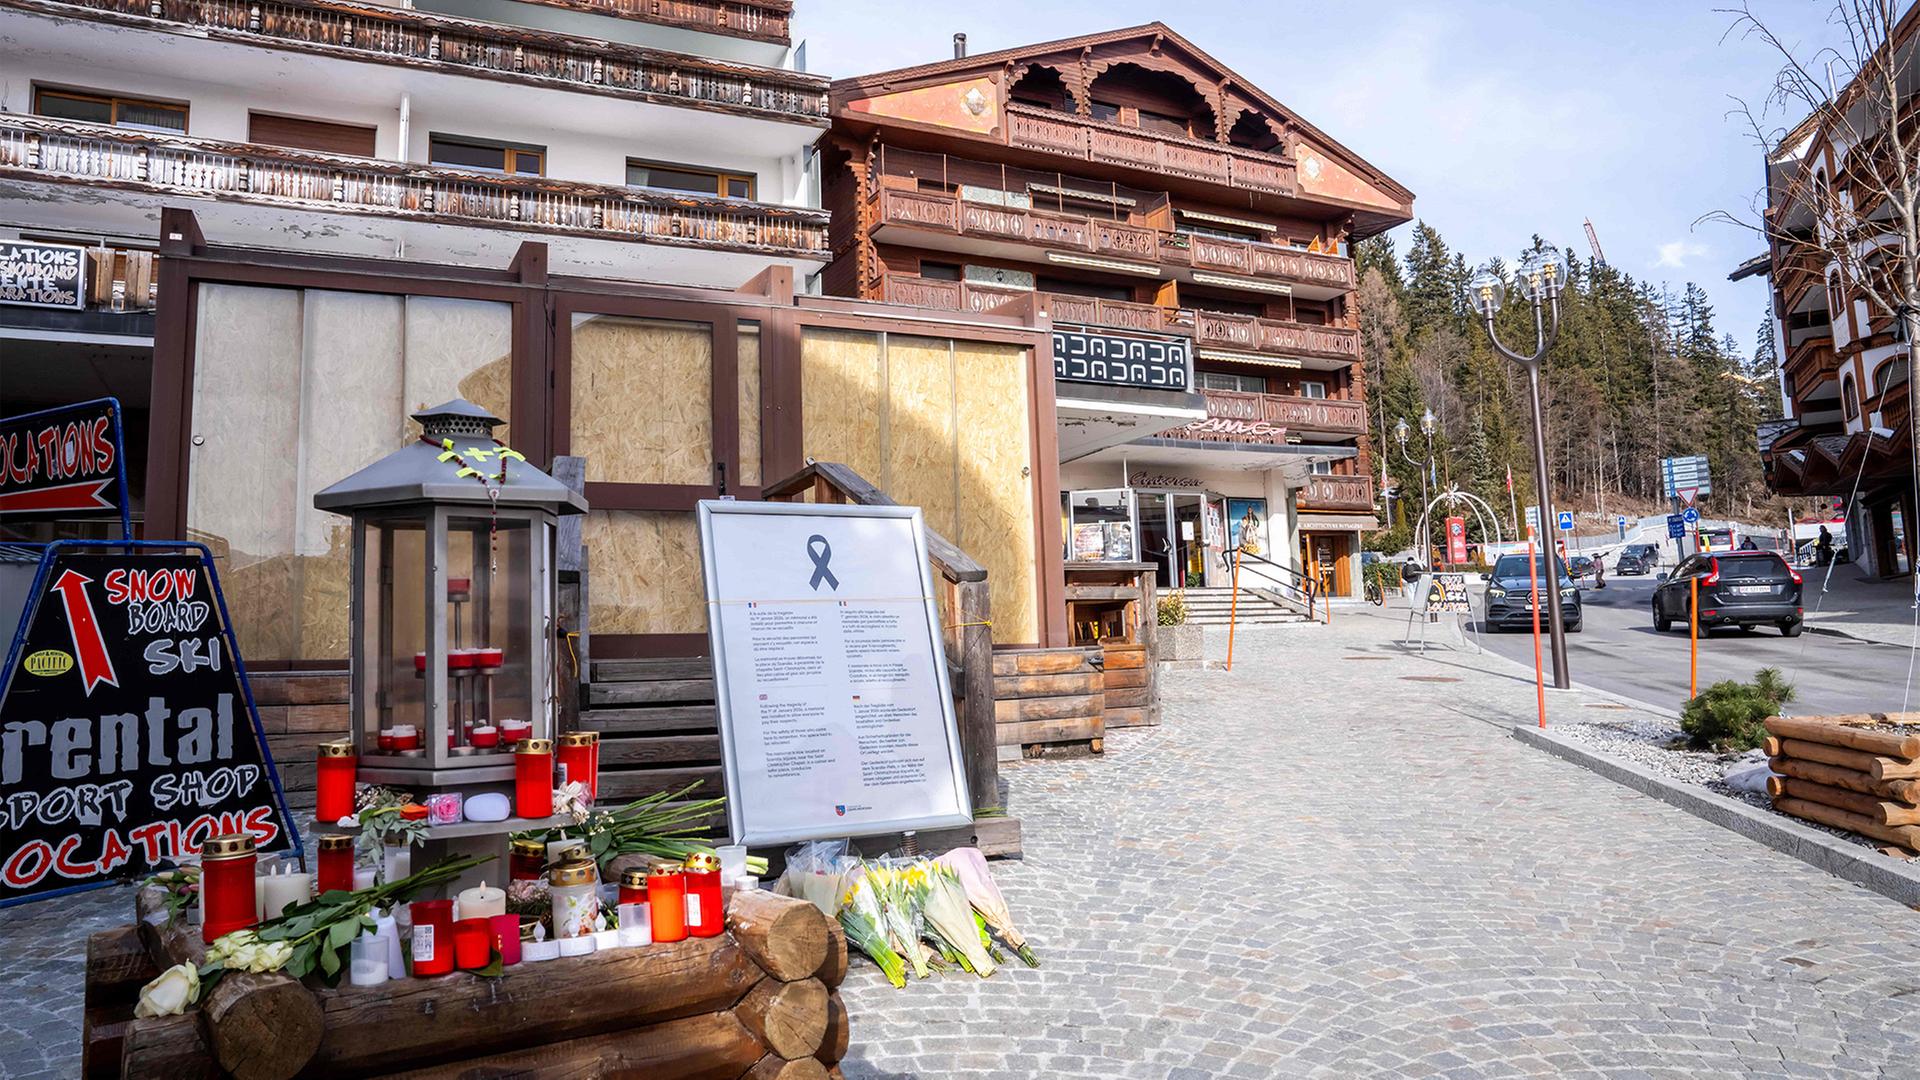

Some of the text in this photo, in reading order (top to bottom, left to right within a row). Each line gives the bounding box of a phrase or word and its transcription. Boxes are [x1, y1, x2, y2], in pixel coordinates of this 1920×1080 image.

[104, 568, 196, 604] SNOW
[127, 601, 209, 635] BOARD
[143, 637, 220, 675] SKI
[1, 693, 234, 785] rental
[151, 764, 259, 811] SHOP
